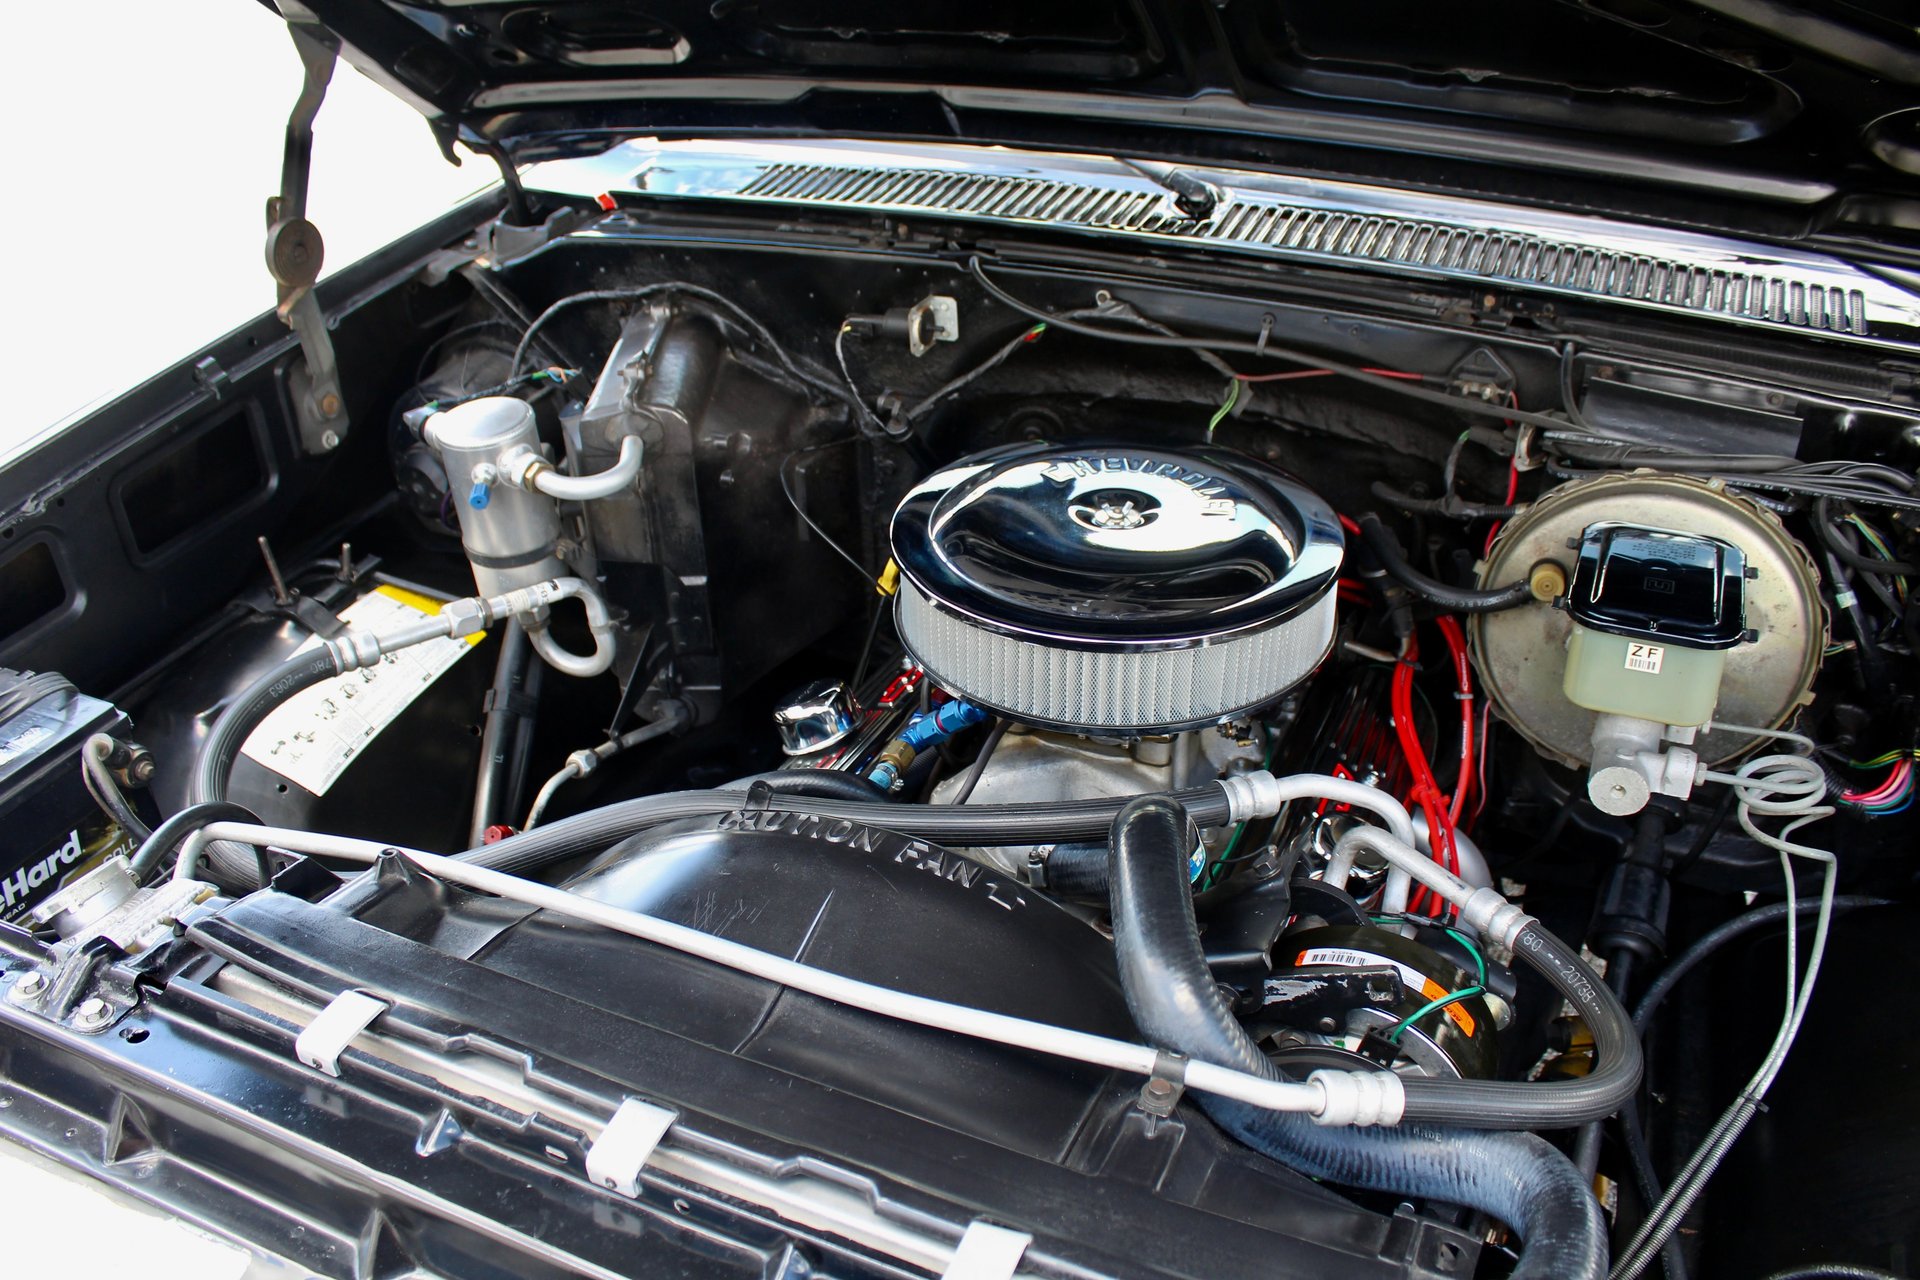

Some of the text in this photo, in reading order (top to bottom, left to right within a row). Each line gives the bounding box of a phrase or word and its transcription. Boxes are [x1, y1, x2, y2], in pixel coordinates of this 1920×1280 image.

[0, 829, 82, 914] Hard
[717, 809, 984, 889] CAUTION FAN
